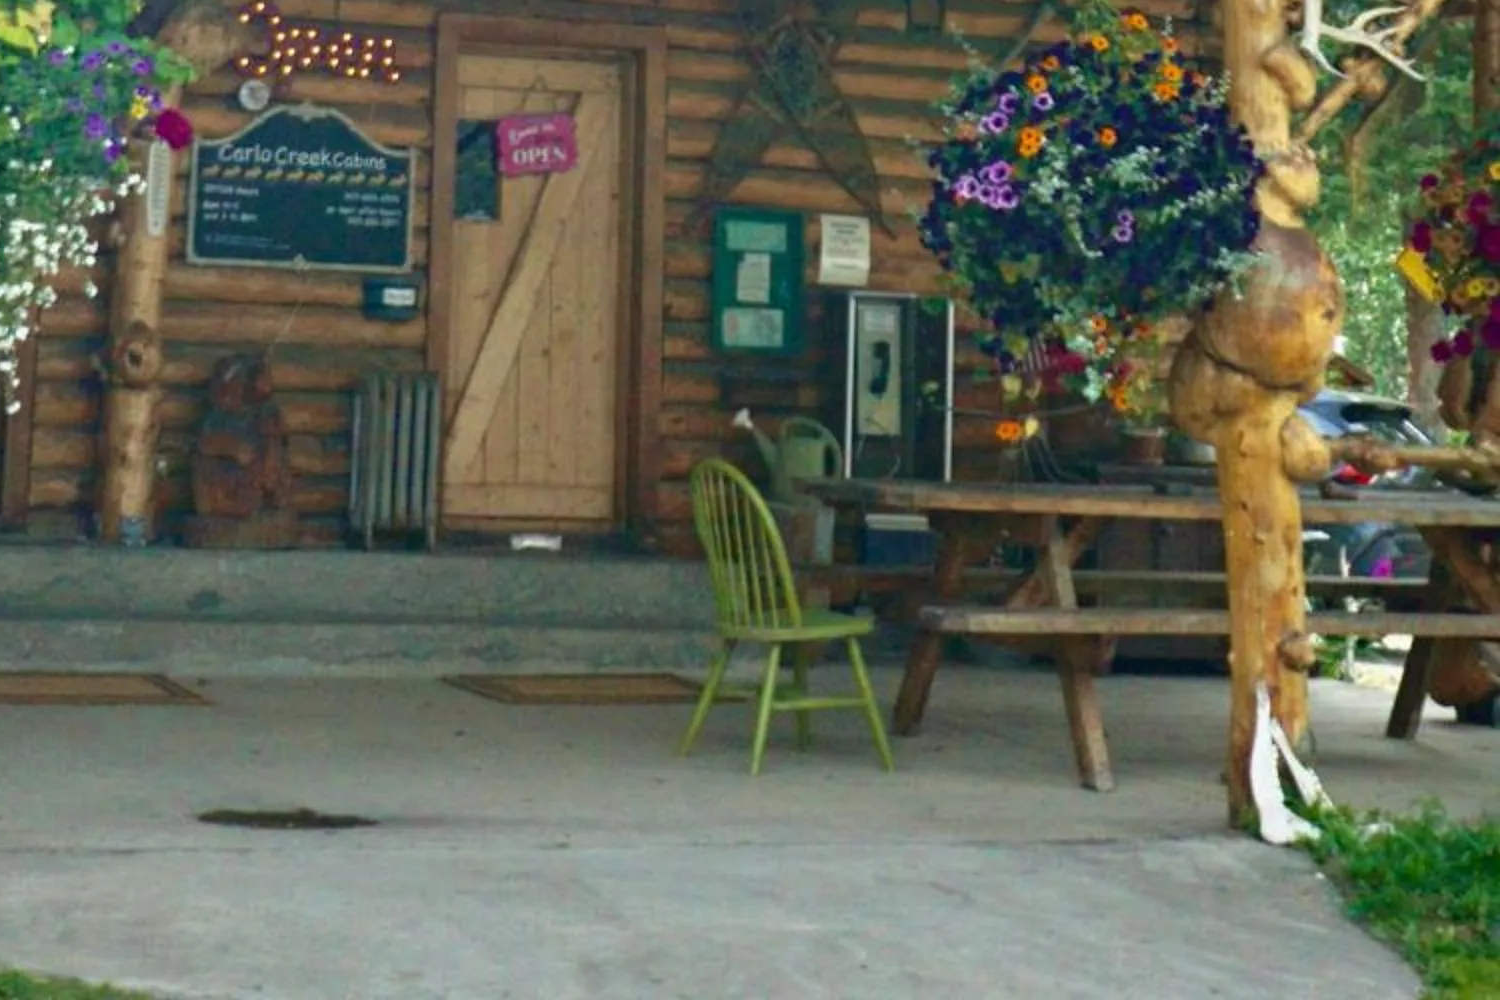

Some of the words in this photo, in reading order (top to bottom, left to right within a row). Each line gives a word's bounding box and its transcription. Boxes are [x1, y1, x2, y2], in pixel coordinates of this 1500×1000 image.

[218, 143, 272, 164] Carlo
[274, 145, 332, 167] Creek
[332, 151, 387, 171] Cabins
[512, 146, 568, 165] OPEN
